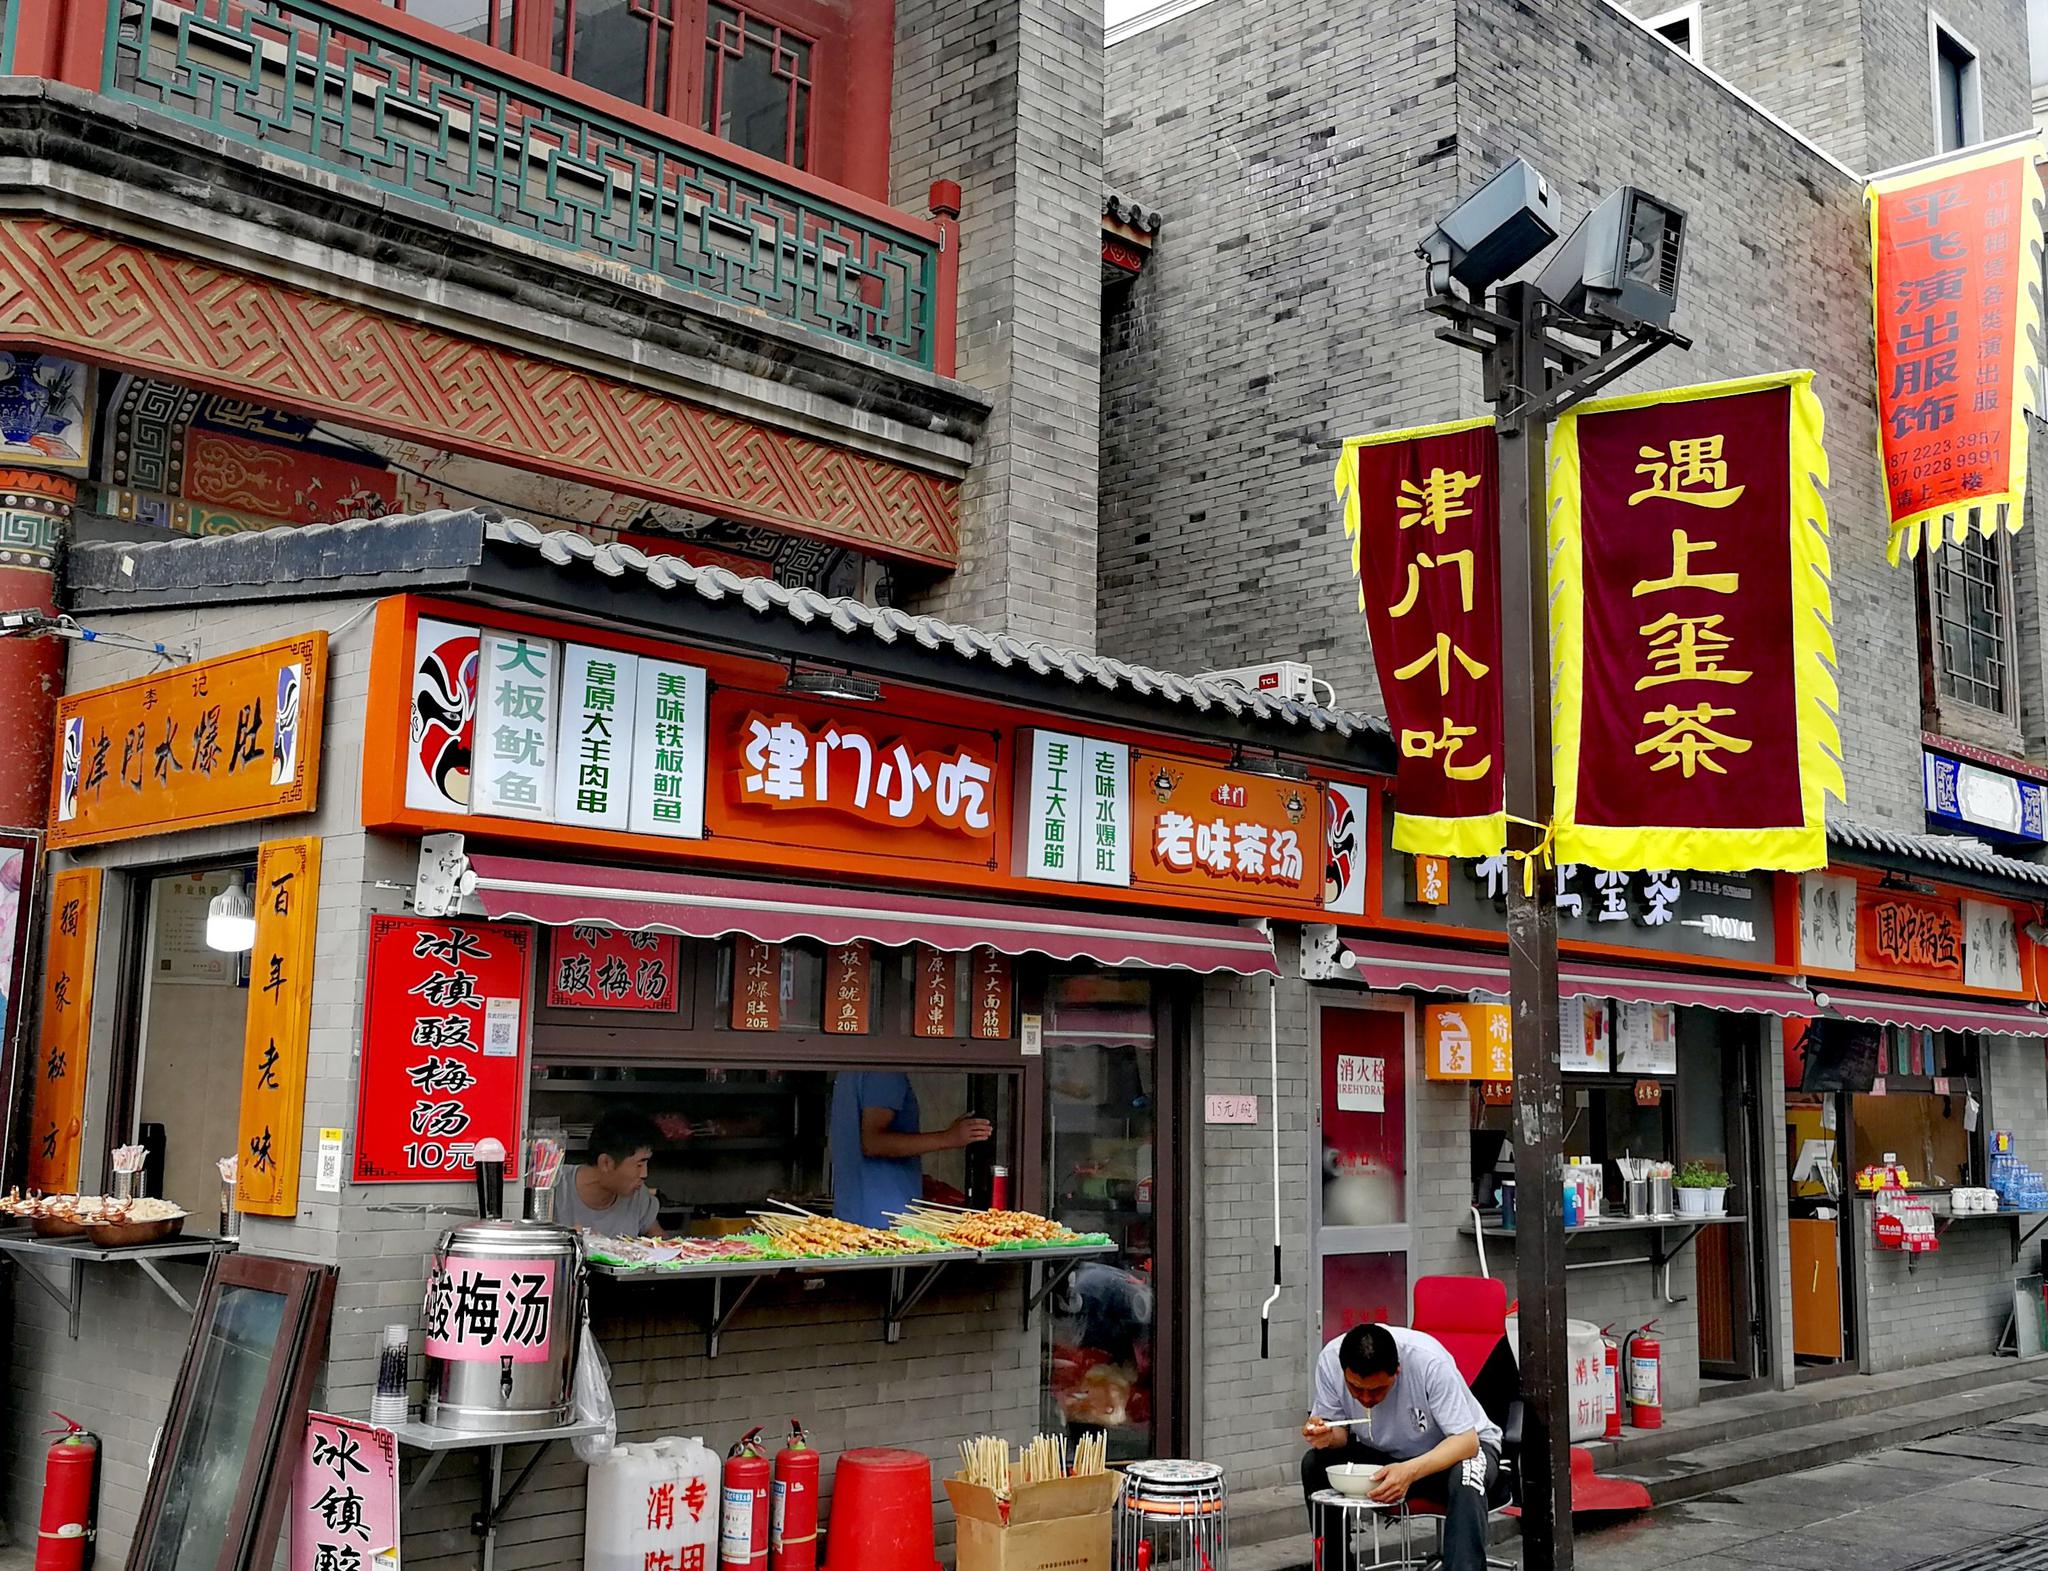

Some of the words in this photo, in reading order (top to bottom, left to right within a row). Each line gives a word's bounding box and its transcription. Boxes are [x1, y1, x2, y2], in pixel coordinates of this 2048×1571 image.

[1888, 182, 1970, 440] 平飞演出服饰
[1913, 439, 1951, 462] 2223
[1956, 431, 2000, 449] 3957
[1913, 457, 1952, 480] 0228
[1388, 467, 1492, 781] 津门小吃
[1628, 434, 1754, 778] 遇上玺茶
[143, 675, 209, 711] 李记
[1261, 677, 1277, 687] TCL
[492, 638, 547, 811] 大板鱿鱼
[576, 659, 617, 814] 草原大羊肉串
[652, 671, 686, 824] 美味铁板鱿鱼
[745, 719, 991, 829] 津门小吃
[1217, 783, 1245, 808] 津门
[1043, 741, 1069, 870] 手工大面筋
[1095, 751, 1117, 873] 老味水爆肚
[1157, 811, 1303, 881] 老味茶汤
[1710, 914, 1757, 942] ROYAL
[558, 953, 668, 1000] 酸梅汤
[250, 872, 296, 1174] 百年老味
[408, 927, 491, 1137] 冰镇酸梅汤
[745, 1017, 769, 1028] 20元
[837, 1021, 859, 1032] 20元
[926, 1025, 944, 1035] 15元
[982, 1027, 1000, 1037] 10元
[1340, 1058, 1385, 1083] 消火栓
[403, 1143, 477, 1171] 10元
